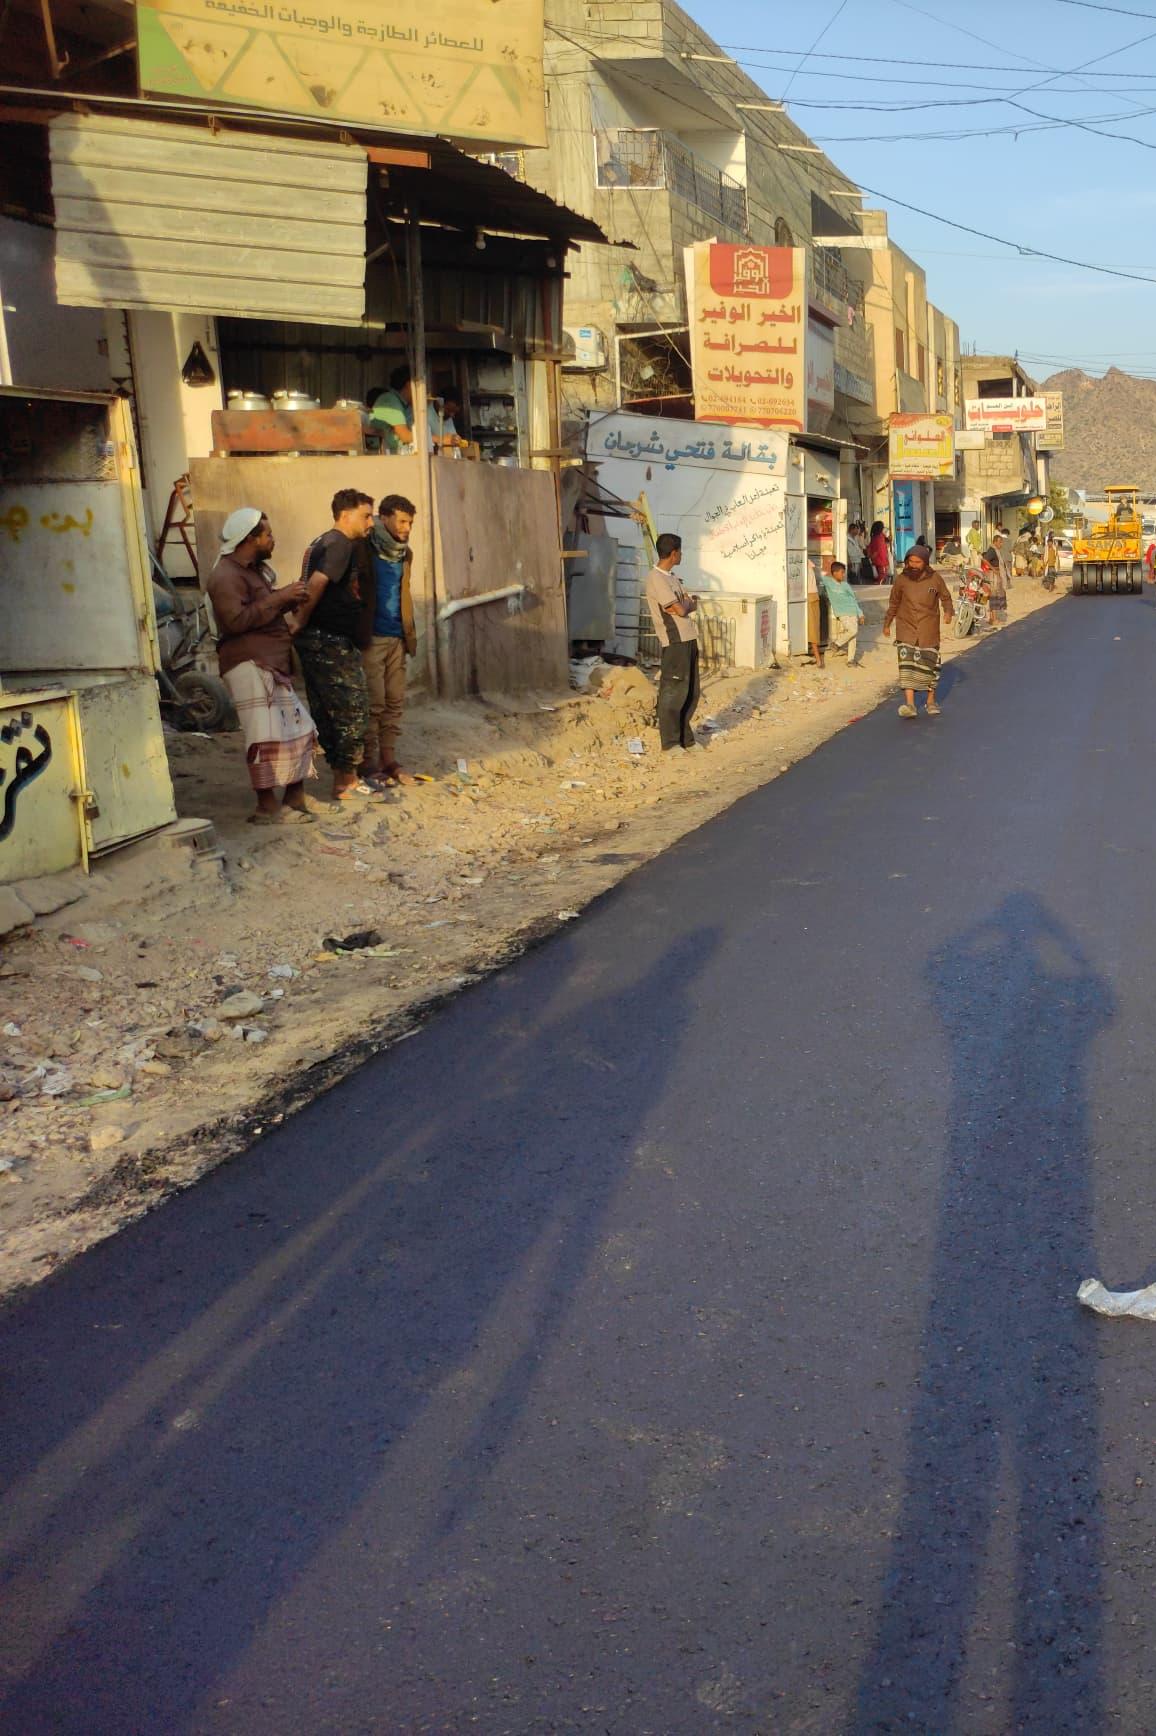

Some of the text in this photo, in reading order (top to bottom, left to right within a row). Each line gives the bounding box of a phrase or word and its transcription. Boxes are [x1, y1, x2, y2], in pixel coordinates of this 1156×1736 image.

[277, 7, 353, 36] والوجبات
[356, 20, 419, 42] الطازجة
[424, 33, 484, 51] للعصائر
[698, 301, 801, 326] الخير الوفير
[703, 331, 798, 355] للصرافة
[707, 365, 794, 390] والتحويلات
[665, 441, 715, 471] فتحي
[722, 440, 777, 470] بقالة
